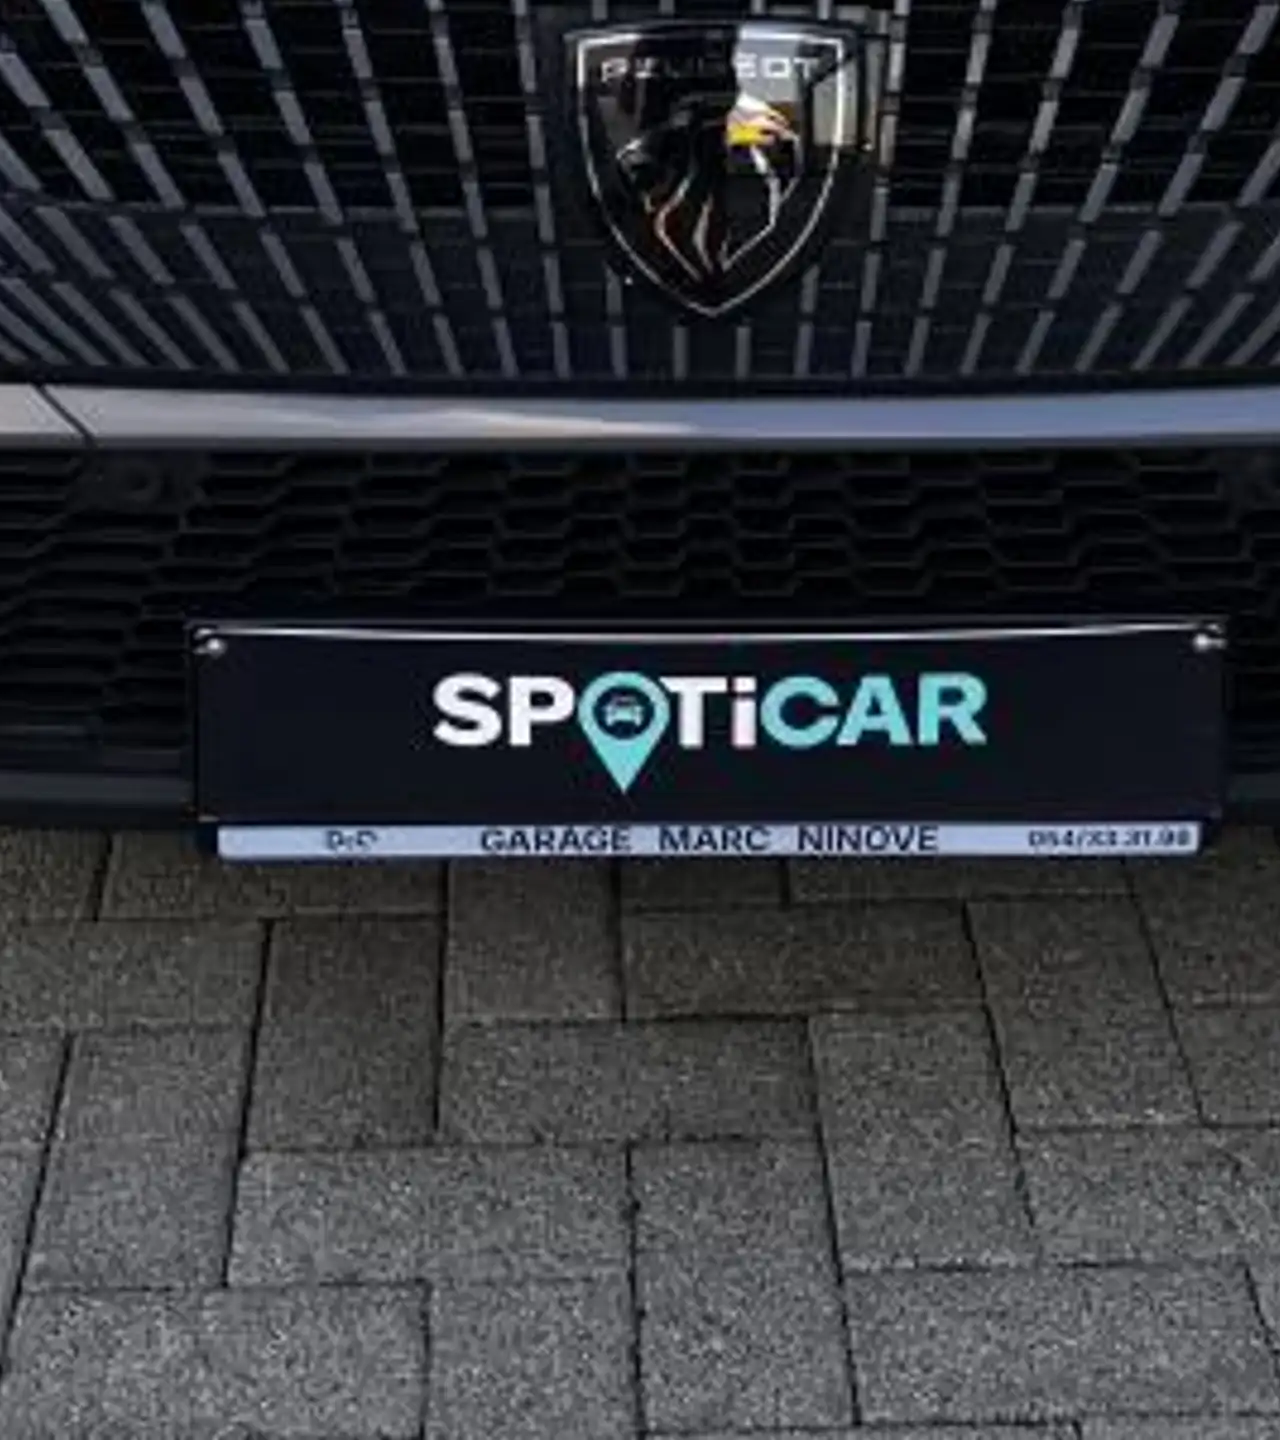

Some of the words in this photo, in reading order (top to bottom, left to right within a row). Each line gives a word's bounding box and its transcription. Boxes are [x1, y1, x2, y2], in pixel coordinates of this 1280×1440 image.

[600, 52, 820, 83] PEEOT
[480, 827, 631, 852] GARAGE
[658, 826, 771, 852] MARC
[797, 825, 939, 851] NINOVE
